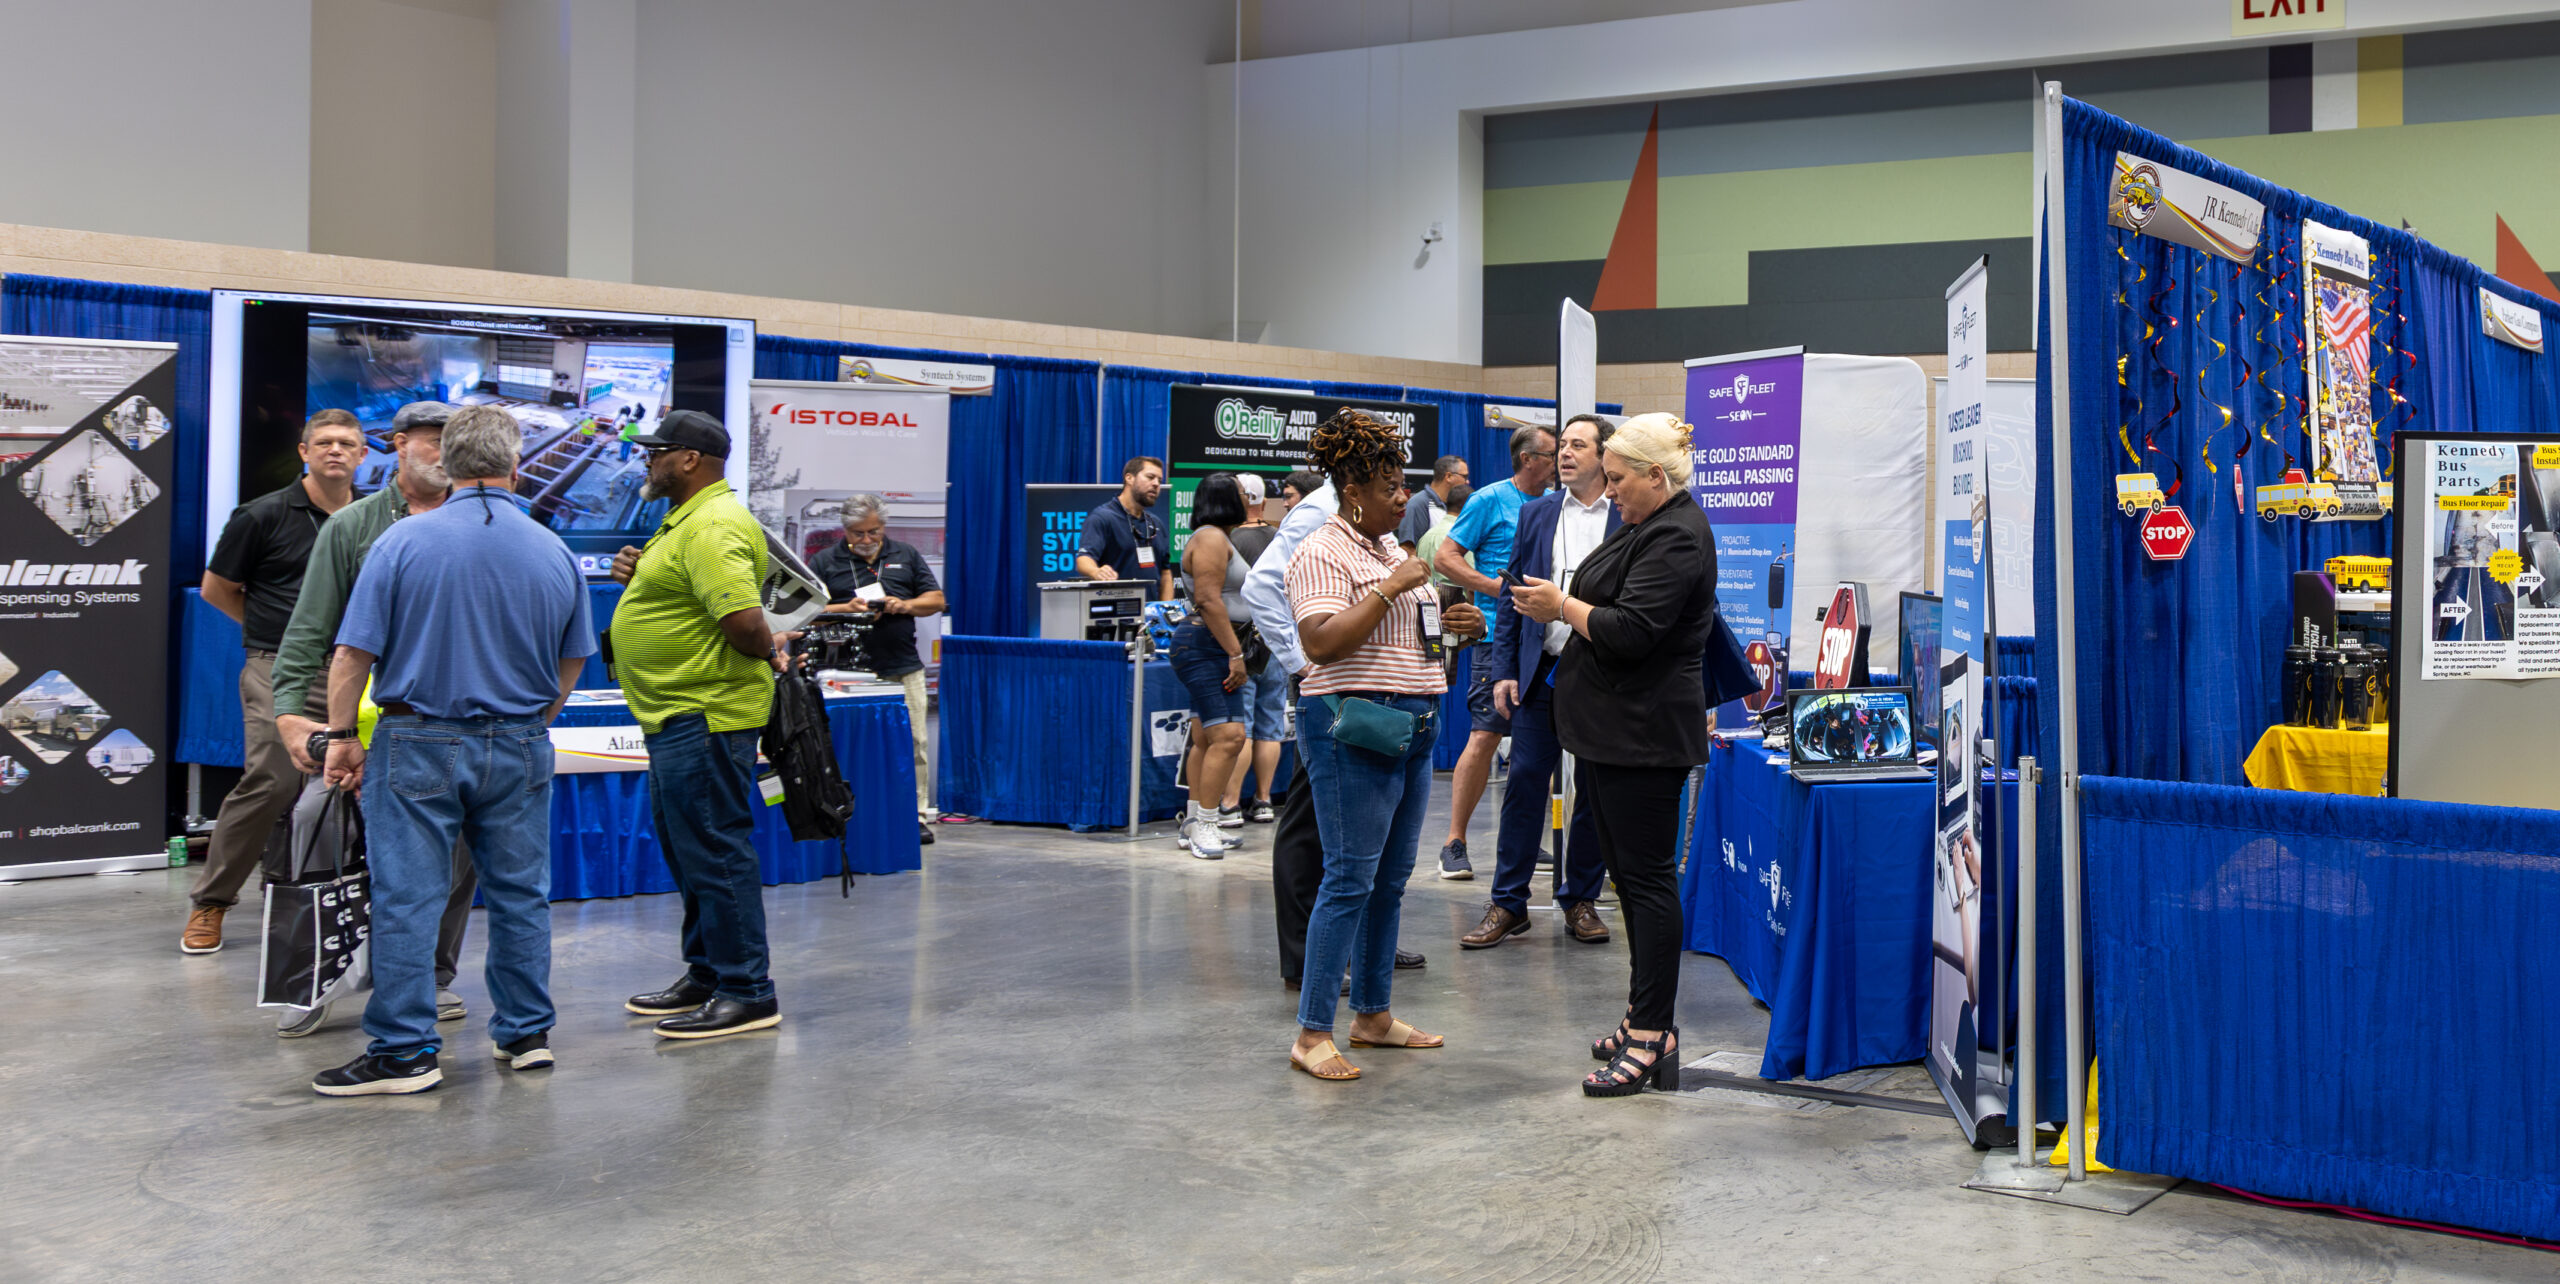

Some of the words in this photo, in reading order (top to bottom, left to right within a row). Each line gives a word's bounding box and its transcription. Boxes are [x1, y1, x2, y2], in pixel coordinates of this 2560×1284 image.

[2200, 196, 2218, 221] JR
[2218, 202, 2246, 235] Kennedy
[2317, 242, 2344, 267] Kennedy
[2345, 250, 2354, 266] Bus
[920, 368, 954, 380] Syntech
[955, 371, 986, 383] Systems
[1709, 386, 1733, 399] SAFE
[1749, 382, 1776, 394] FLEET
[790, 410, 917, 427] ISTOBAL
[1219, 403, 1286, 441] O'Reilly
[1289, 410, 1317, 425] AUTO
[1729, 410, 1752, 422] SEON
[1205, 447, 1247, 456] DEDICATED
[1248, 449, 1258, 457] TO
[1259, 450, 1274, 458] THE
[1275, 450, 1312, 459] PROFESS
[1709, 448, 1736, 464] GOLD
[1738, 444, 1794, 463] STANDARD
[2438, 445, 2506, 460] Kennedy
[2438, 461, 2467, 471] Bus
[1698, 469, 1742, 487] ILLEGAL
[1744, 467, 1794, 485] PASSING
[2438, 476, 2481, 487] Parts
[1701, 491, 1775, 509] TECHNOLOGY
[2442, 499, 2456, 508] Bus
[2459, 499, 2479, 507] Floor
[2481, 500, 2506, 509] Repair
[1042, 511, 1087, 530] THE
[2491, 522, 2514, 530] Before
[1721, 535, 1751, 545] PROACTIVE
[2146, 526, 2187, 540] STOP
[1752, 548, 1763, 557] Stop
[1763, 548, 1772, 556] Arm
[1042, 553, 1076, 572] SO
[1733, 582, 1744, 591] Stop
[0, 591, 71, 607] spensing
[74, 590, 141, 606] Systems
[42, 611, 80, 619] Industrial
[1720, 603, 1750, 613] ESPONSIVE
[2443, 606, 2467, 614] AFTER
[1820, 627, 1852, 677] STOP
[28, 821, 141, 839] shopbalcrank.com
